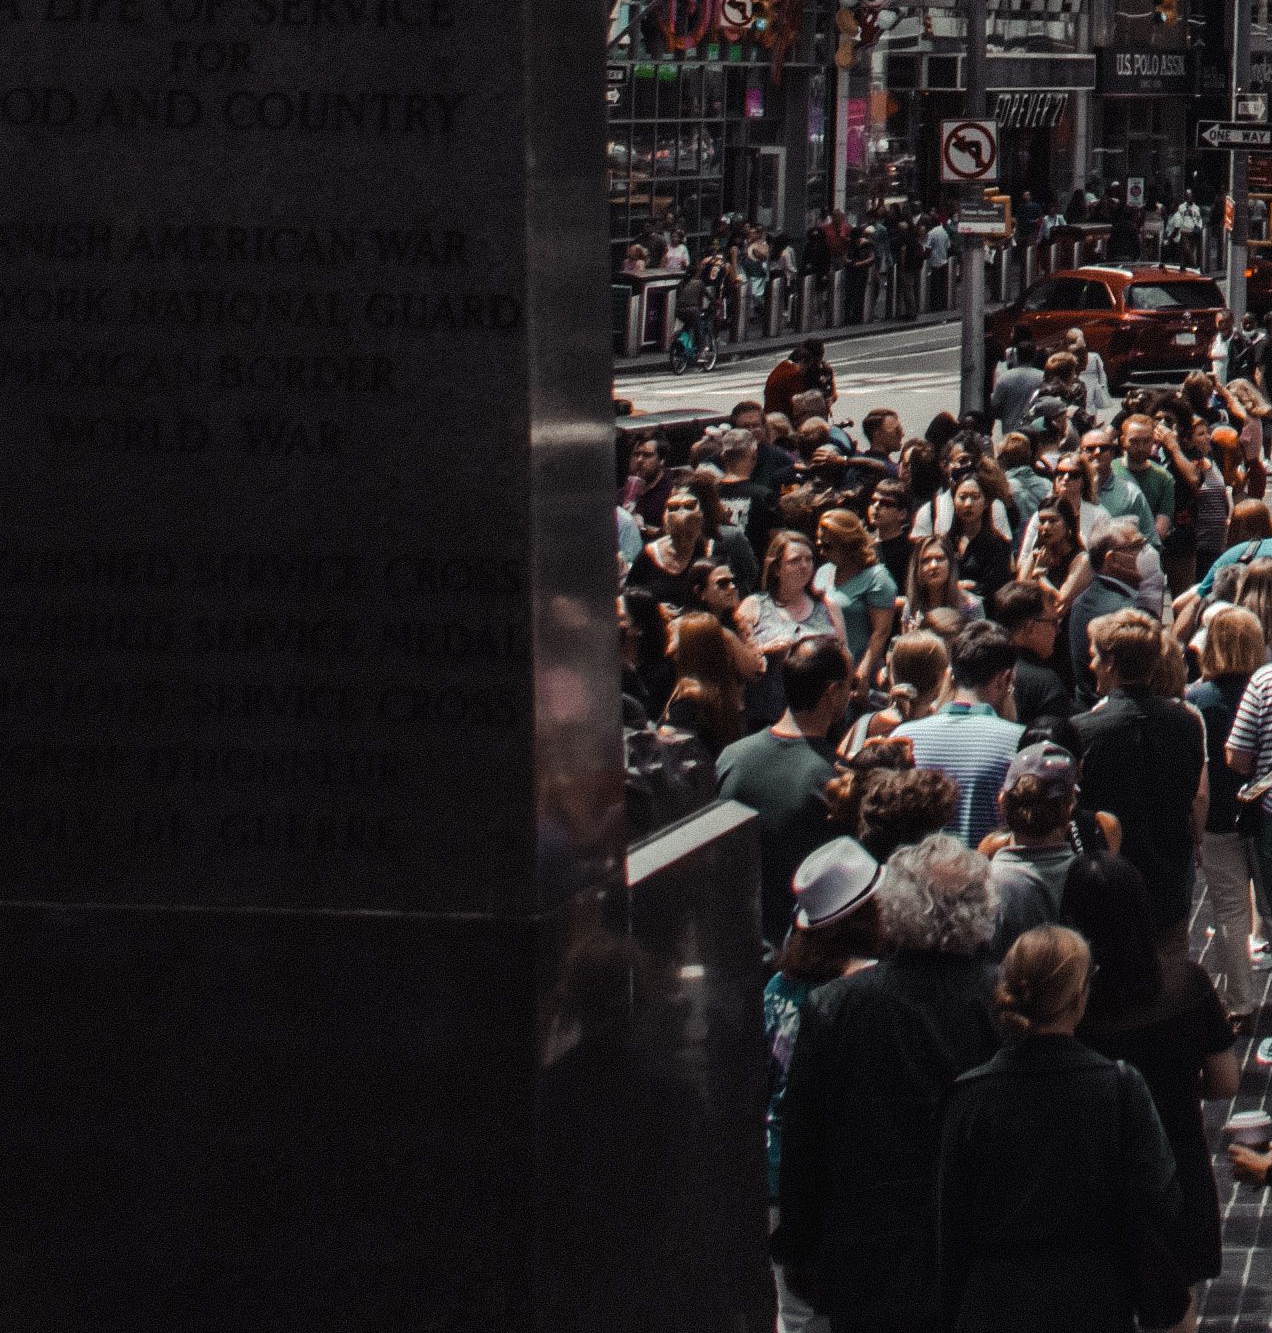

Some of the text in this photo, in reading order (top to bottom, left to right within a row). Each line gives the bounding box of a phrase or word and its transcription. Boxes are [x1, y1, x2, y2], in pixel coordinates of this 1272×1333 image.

[171, 41, 253, 74] FOR
[1134, 55, 1159, 75] POLO
[95, 89, 468, 133] AND COUNTRY
[1242, 131, 1267, 144] WAY
[127, 229, 470, 266] AMERICAN WAR
[131, 289, 522, 331] NATIONAL GUARD
[218, 353, 396, 393] BORDER
